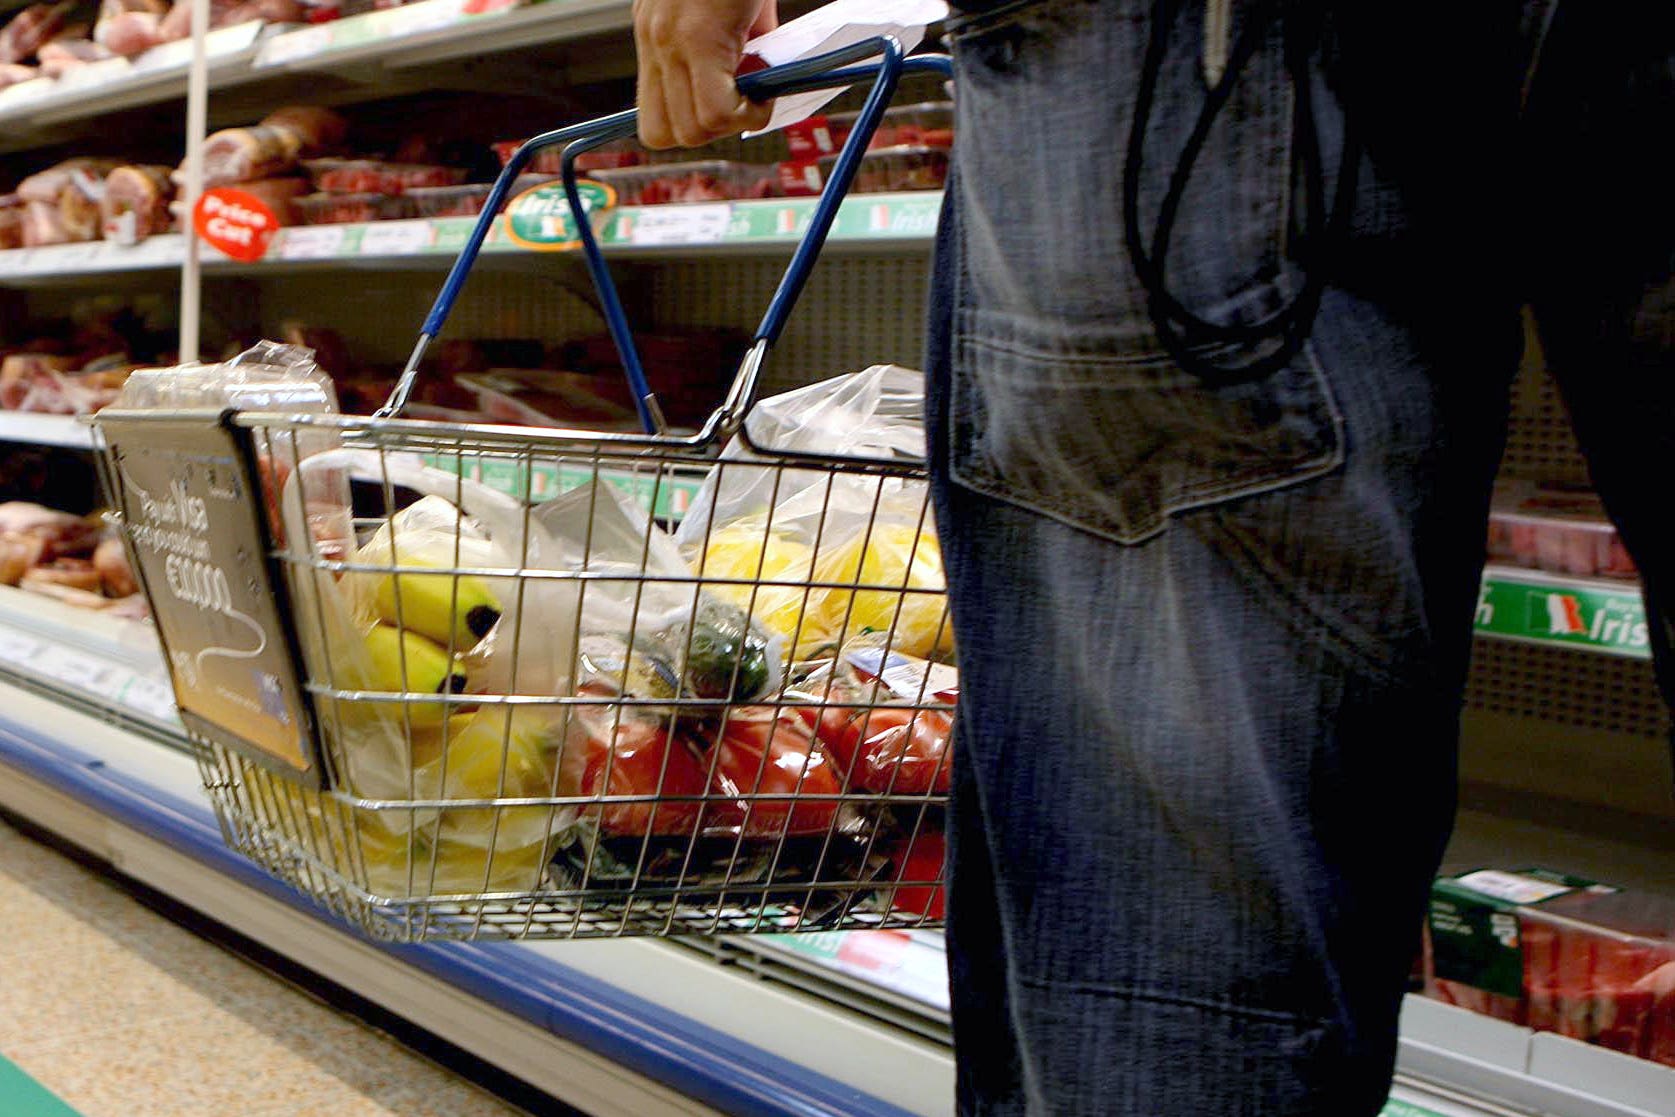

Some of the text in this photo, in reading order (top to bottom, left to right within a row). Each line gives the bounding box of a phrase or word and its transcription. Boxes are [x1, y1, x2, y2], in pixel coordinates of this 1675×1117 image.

[203, 194, 267, 228] Price
[206, 217, 254, 246] Cut
[1589, 607, 1649, 646] Iris
